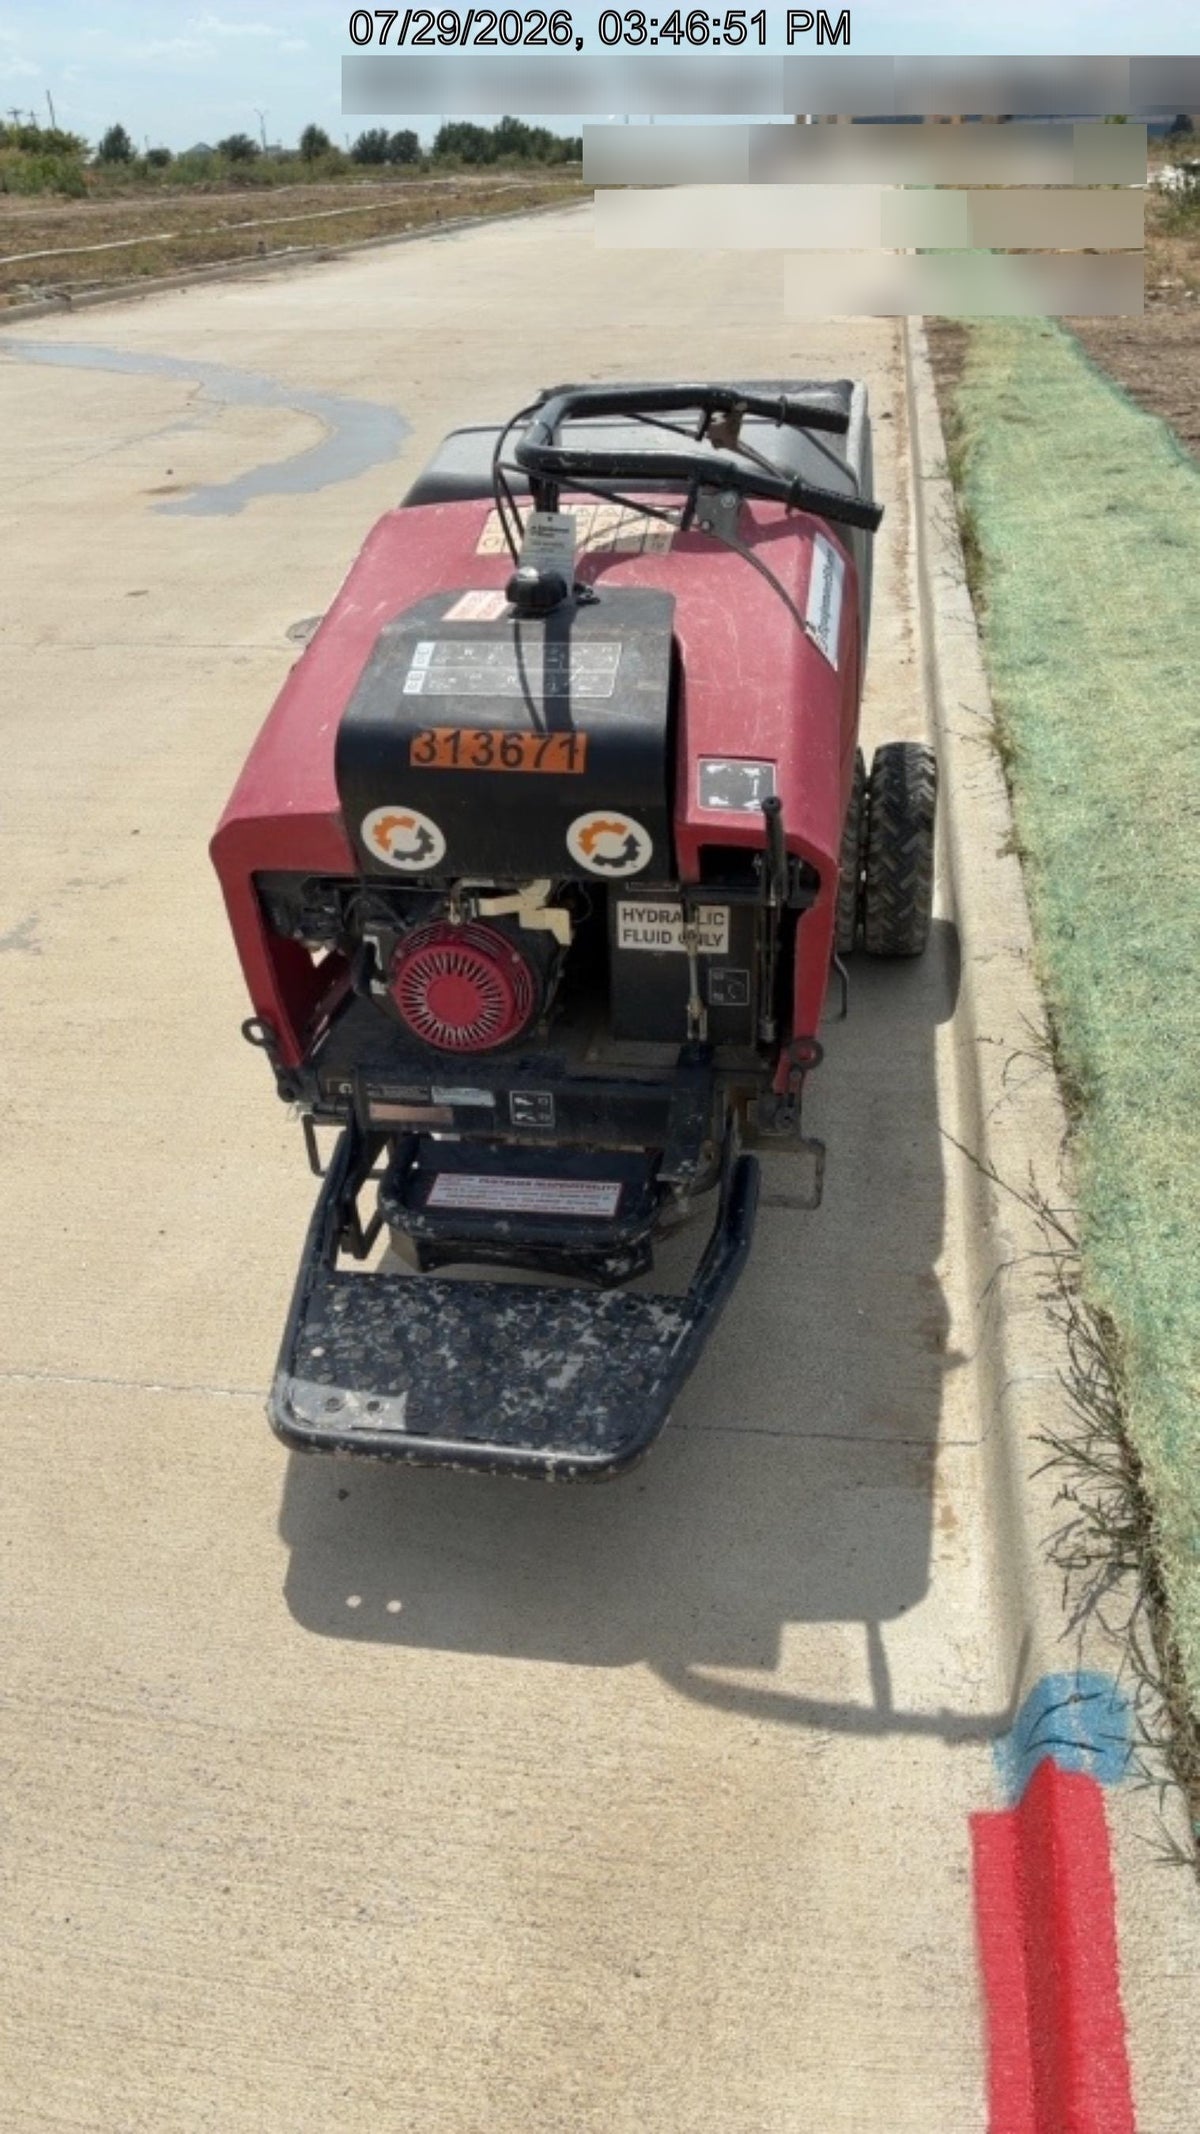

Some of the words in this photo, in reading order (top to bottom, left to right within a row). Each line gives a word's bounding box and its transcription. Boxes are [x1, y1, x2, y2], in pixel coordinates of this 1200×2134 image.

[413, 730, 578, 770] 313671
[623, 907, 725, 925] HYDRALIC
[622, 928, 672, 945] FLUID
